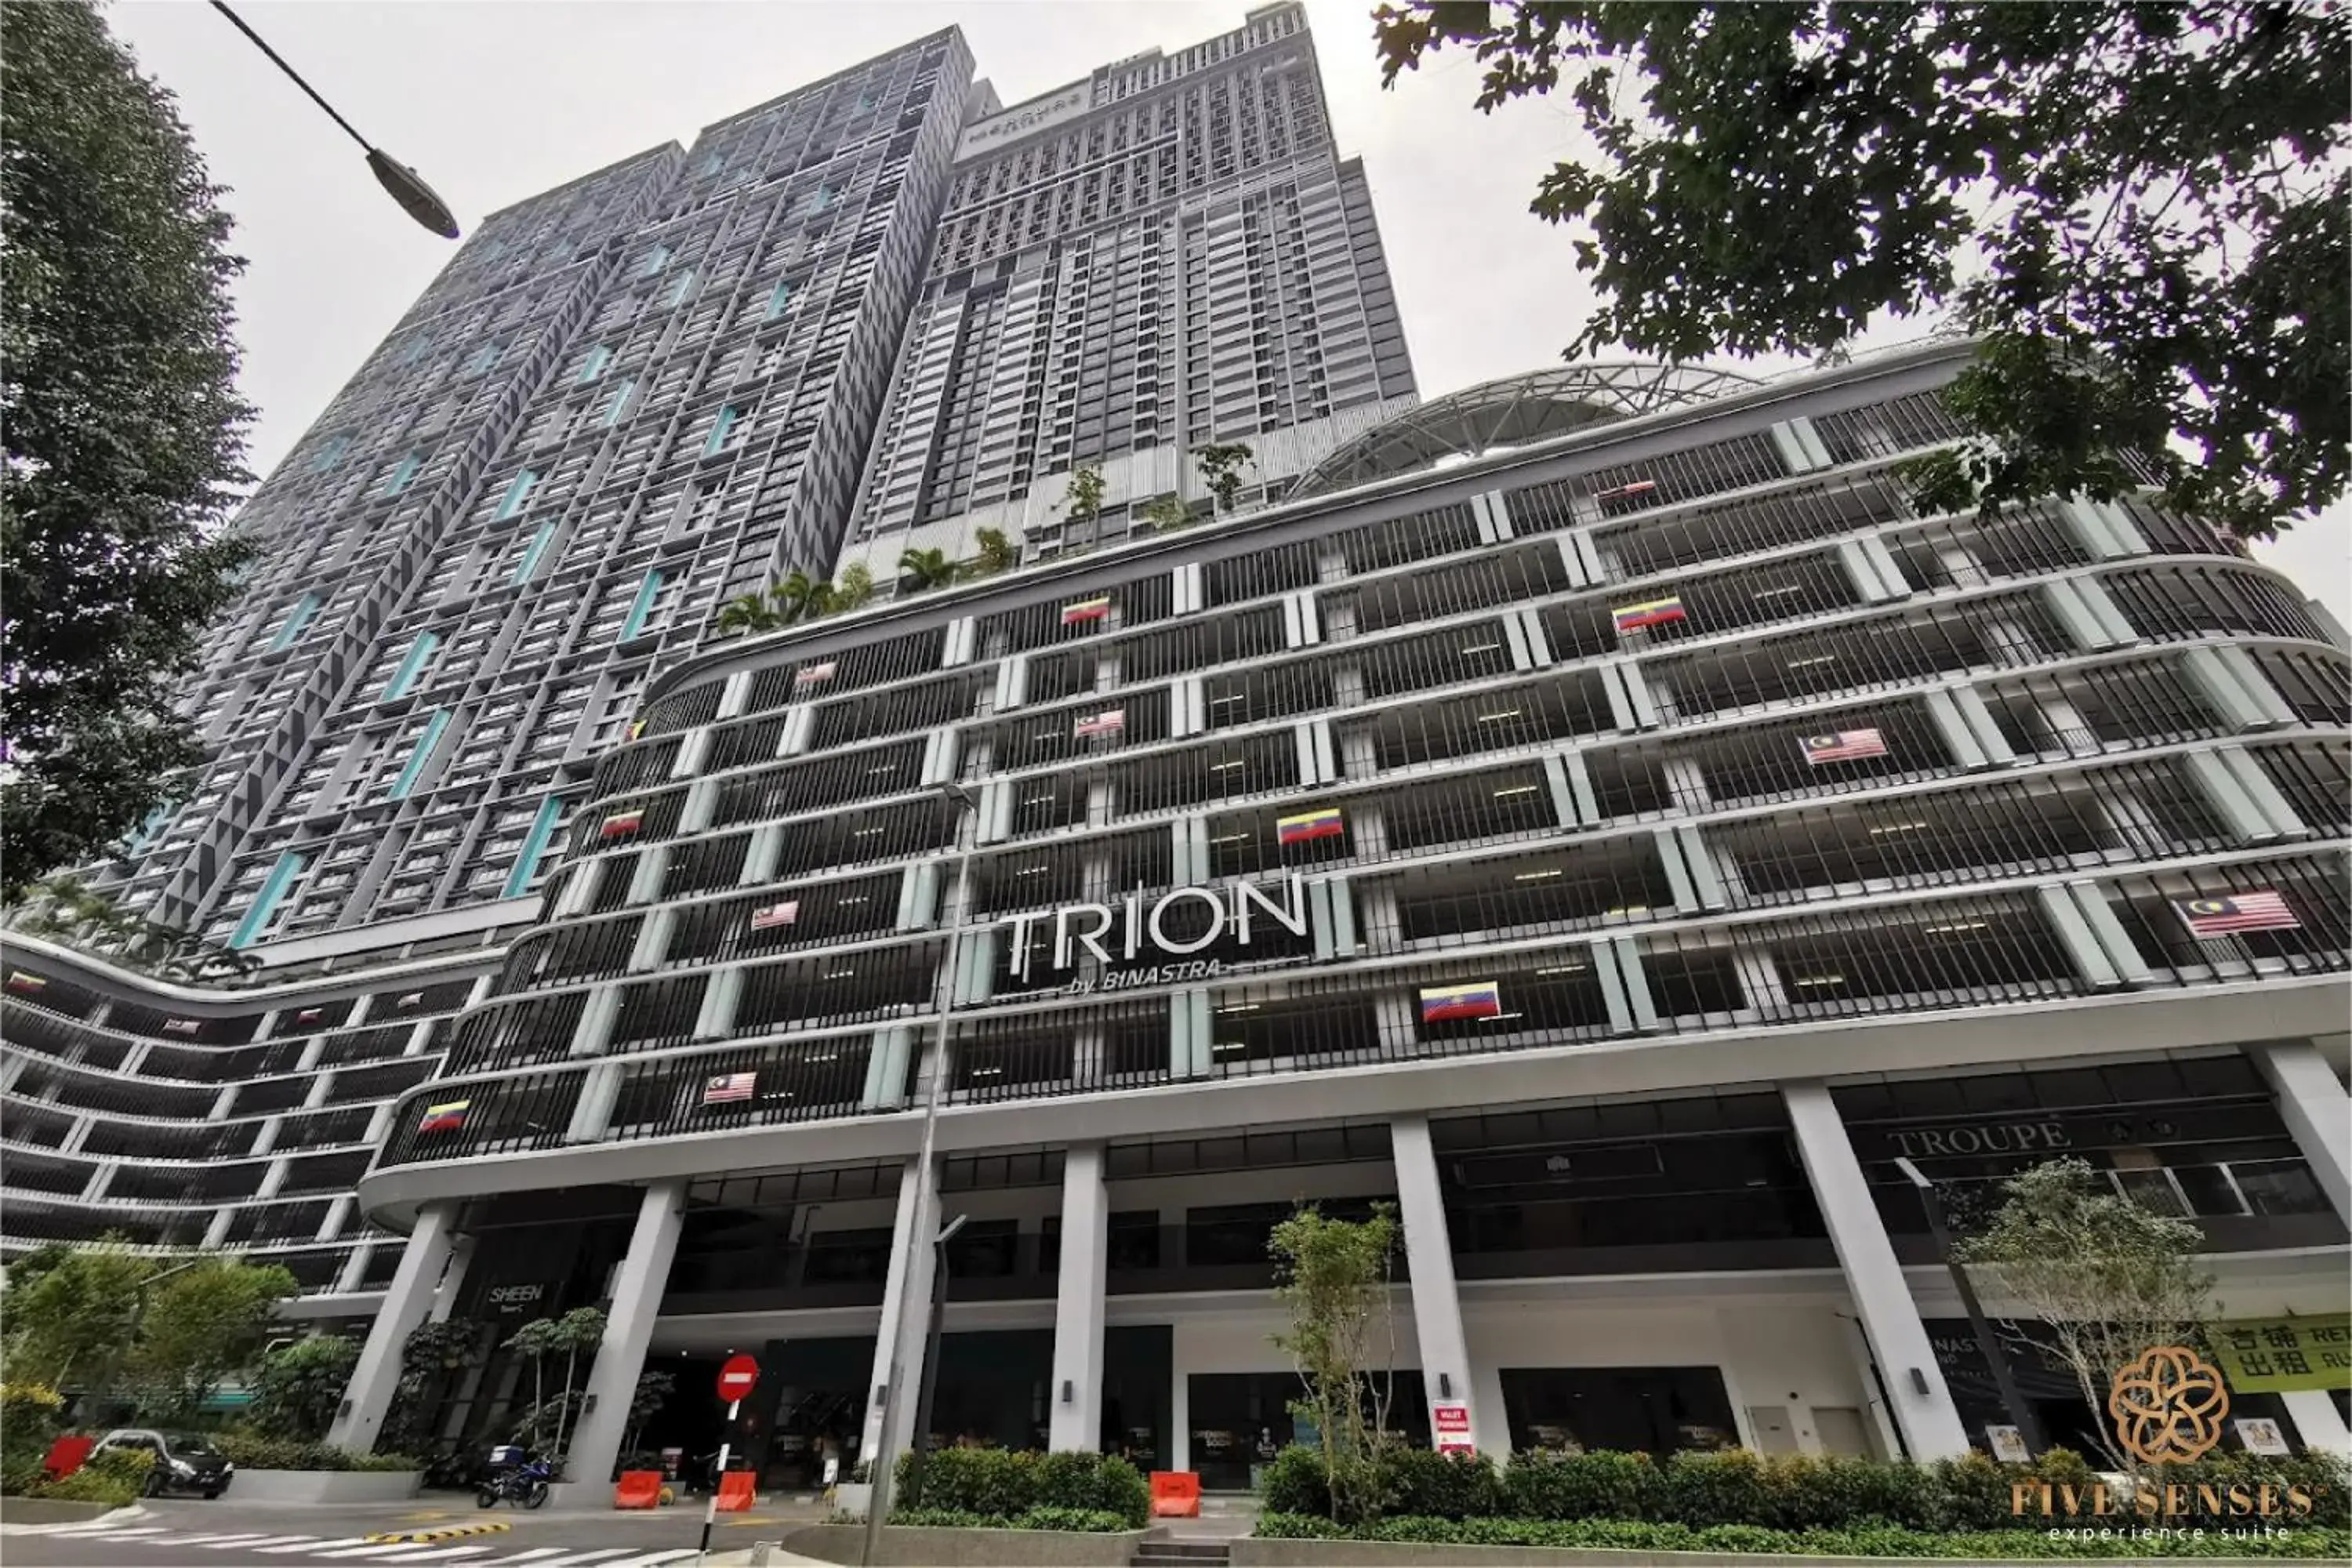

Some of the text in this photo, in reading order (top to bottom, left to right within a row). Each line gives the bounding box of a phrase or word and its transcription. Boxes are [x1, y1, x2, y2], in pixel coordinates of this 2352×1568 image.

[998, 865, 1307, 983] TRION
[1069, 958, 1222, 995] by BINASTRA
[489, 1283, 544, 1302] SHEEN
